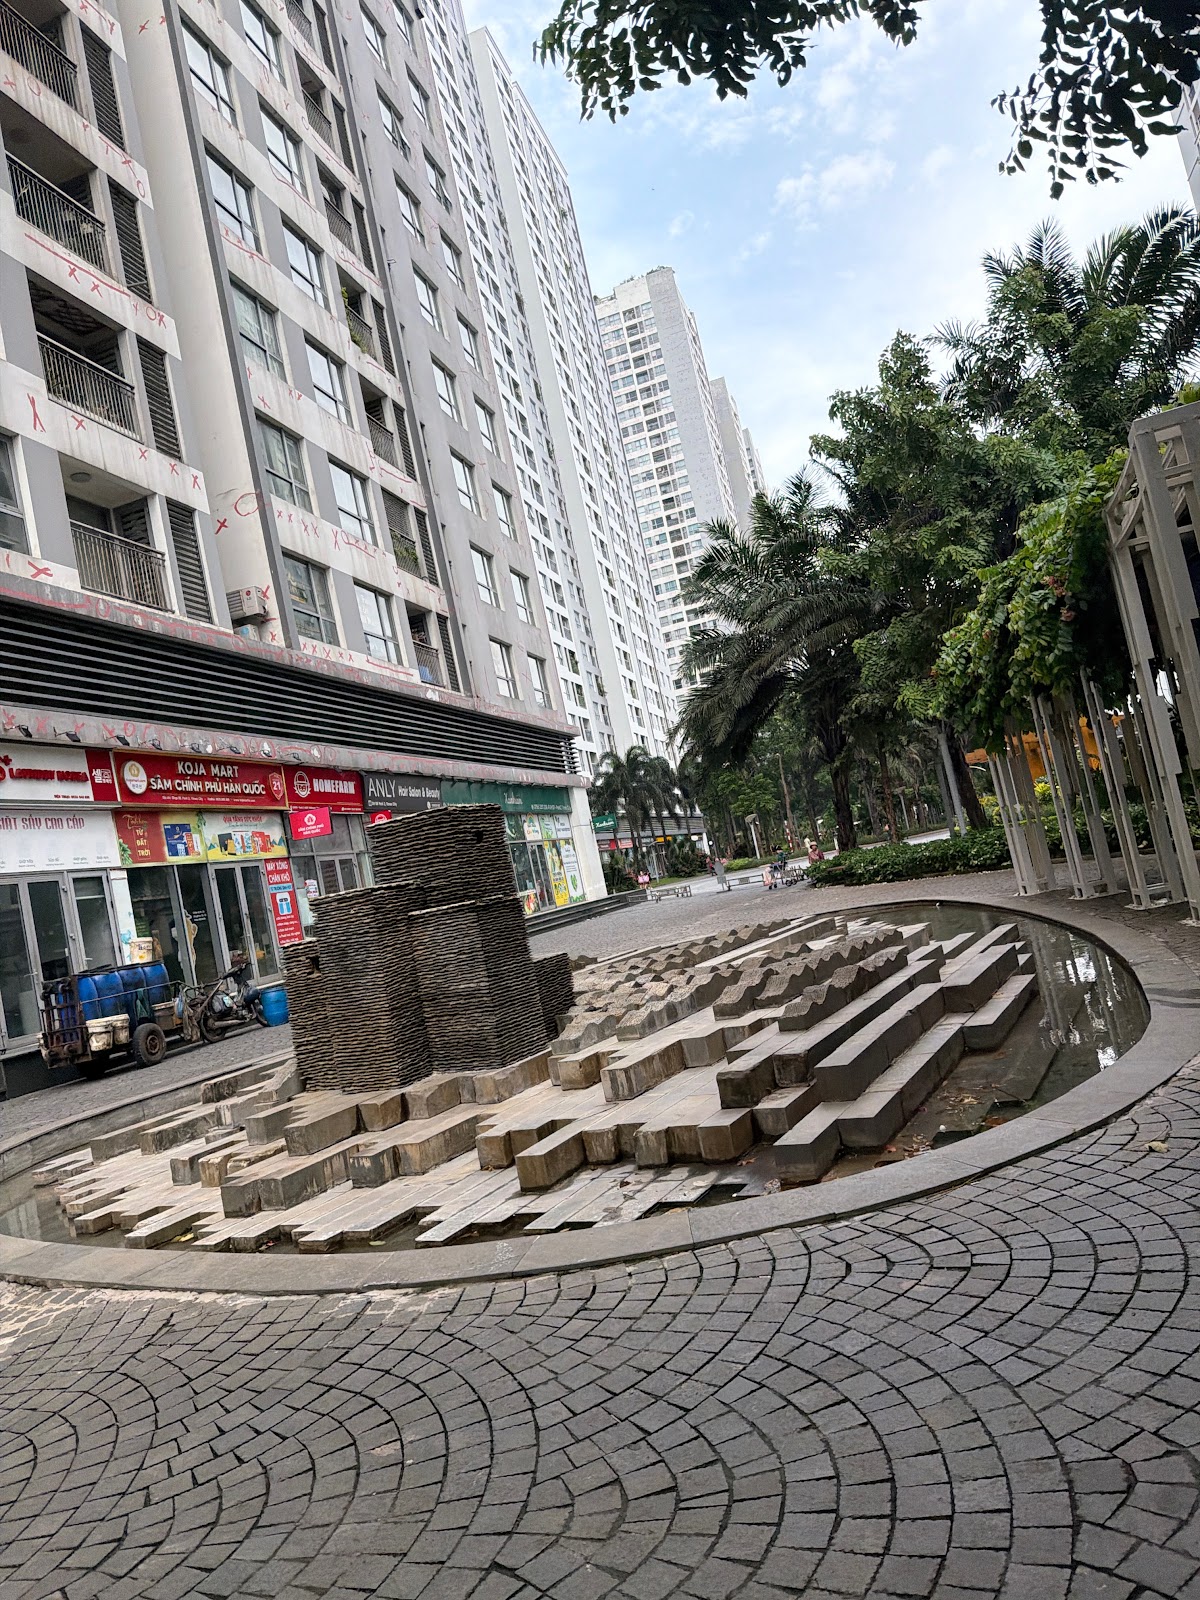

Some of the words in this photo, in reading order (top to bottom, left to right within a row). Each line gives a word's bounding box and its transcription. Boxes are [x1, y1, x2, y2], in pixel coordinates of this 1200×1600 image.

[177, 761, 207, 776] KOJA
[210, 763, 239, 778] MART
[150, 774, 173, 791] SÂM
[174, 776, 203, 792] CHÍNH
[205, 777, 222, 793] PHỦ
[223, 779, 242, 794] HÀN
[242, 780, 266, 795] QUỐC
[273, 781, 281, 791] 21
[312, 778, 355, 794] HOMEFARM
[368, 778, 396, 798] ANLY
[398, 785, 409, 797] Hair
[408, 786, 421, 798] Salon
[426, 787, 440, 800] Beauty
[21, 814, 42, 830] SẤY
[45, 817, 64, 830] CAO
[66, 814, 85, 830] CẤP
